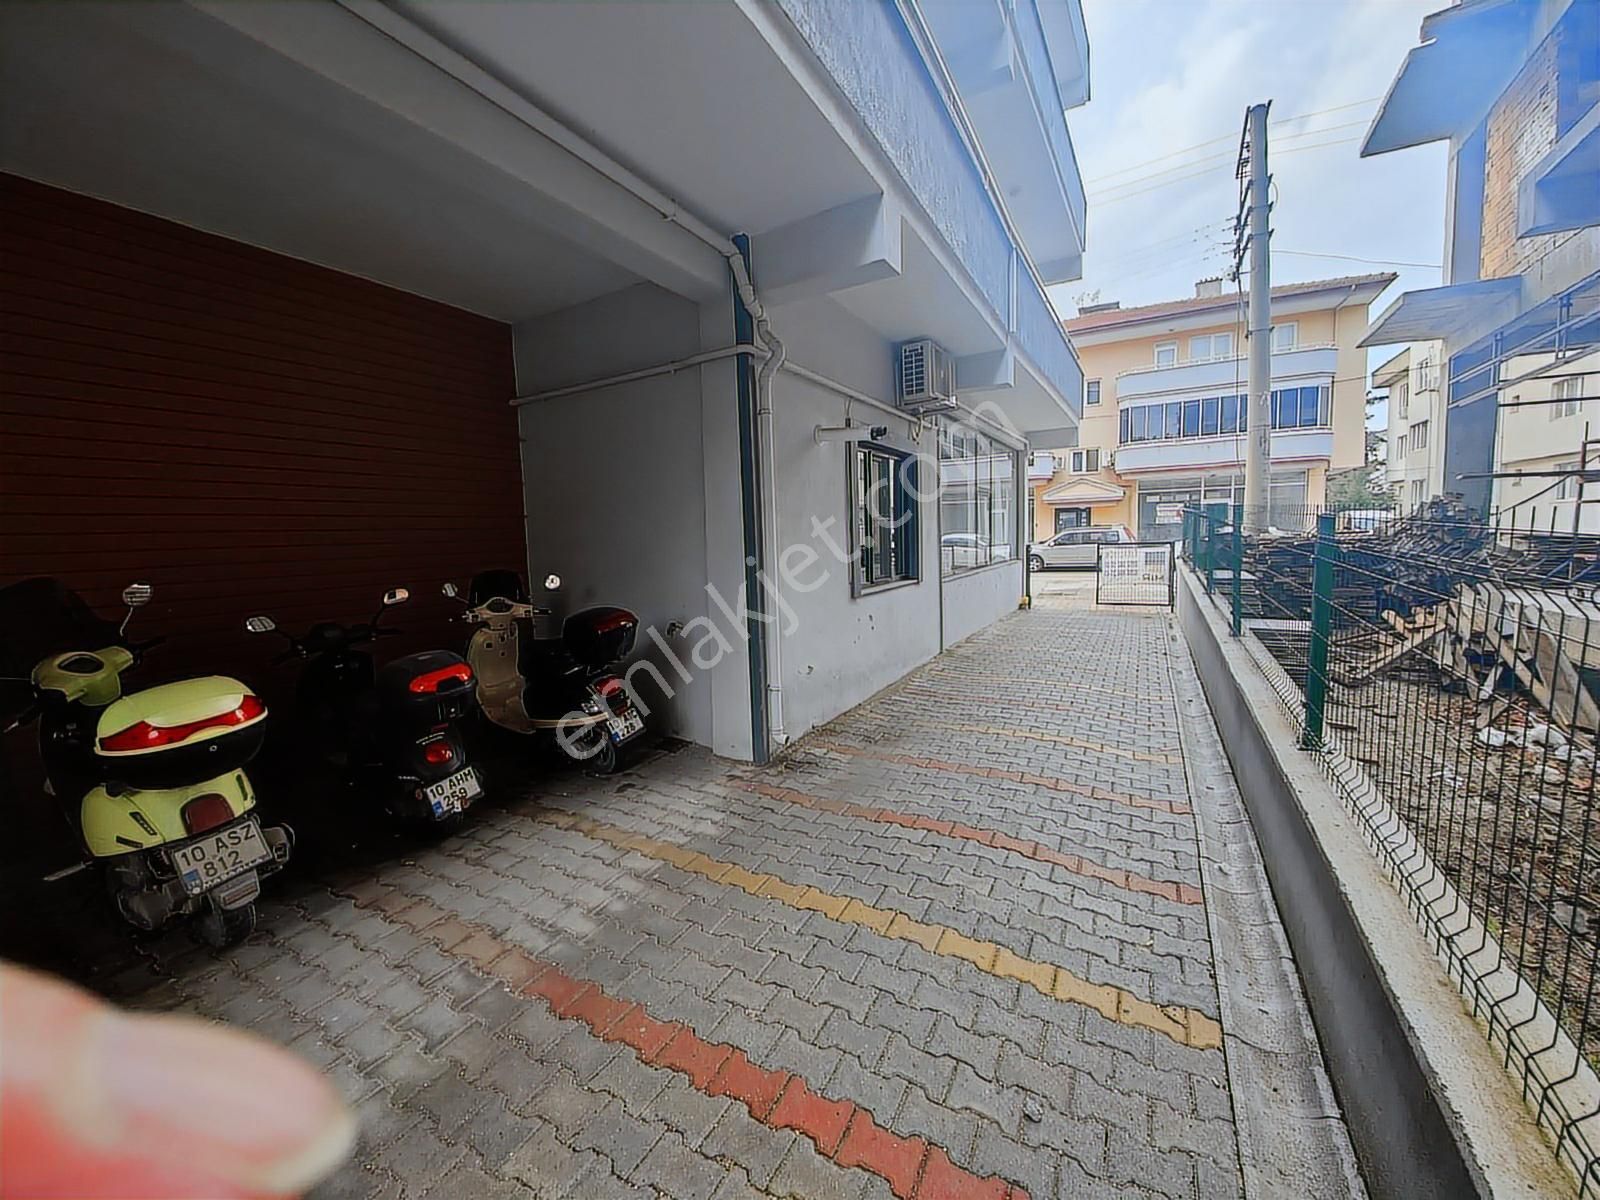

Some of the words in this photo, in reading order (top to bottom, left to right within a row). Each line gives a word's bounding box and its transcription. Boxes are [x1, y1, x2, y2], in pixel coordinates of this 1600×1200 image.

[430, 784, 445, 800] 10
[448, 769, 474, 791] AHM
[181, 845, 206, 867] 10
[214, 823, 256, 854] ASZ
[203, 850, 243, 878] 812
